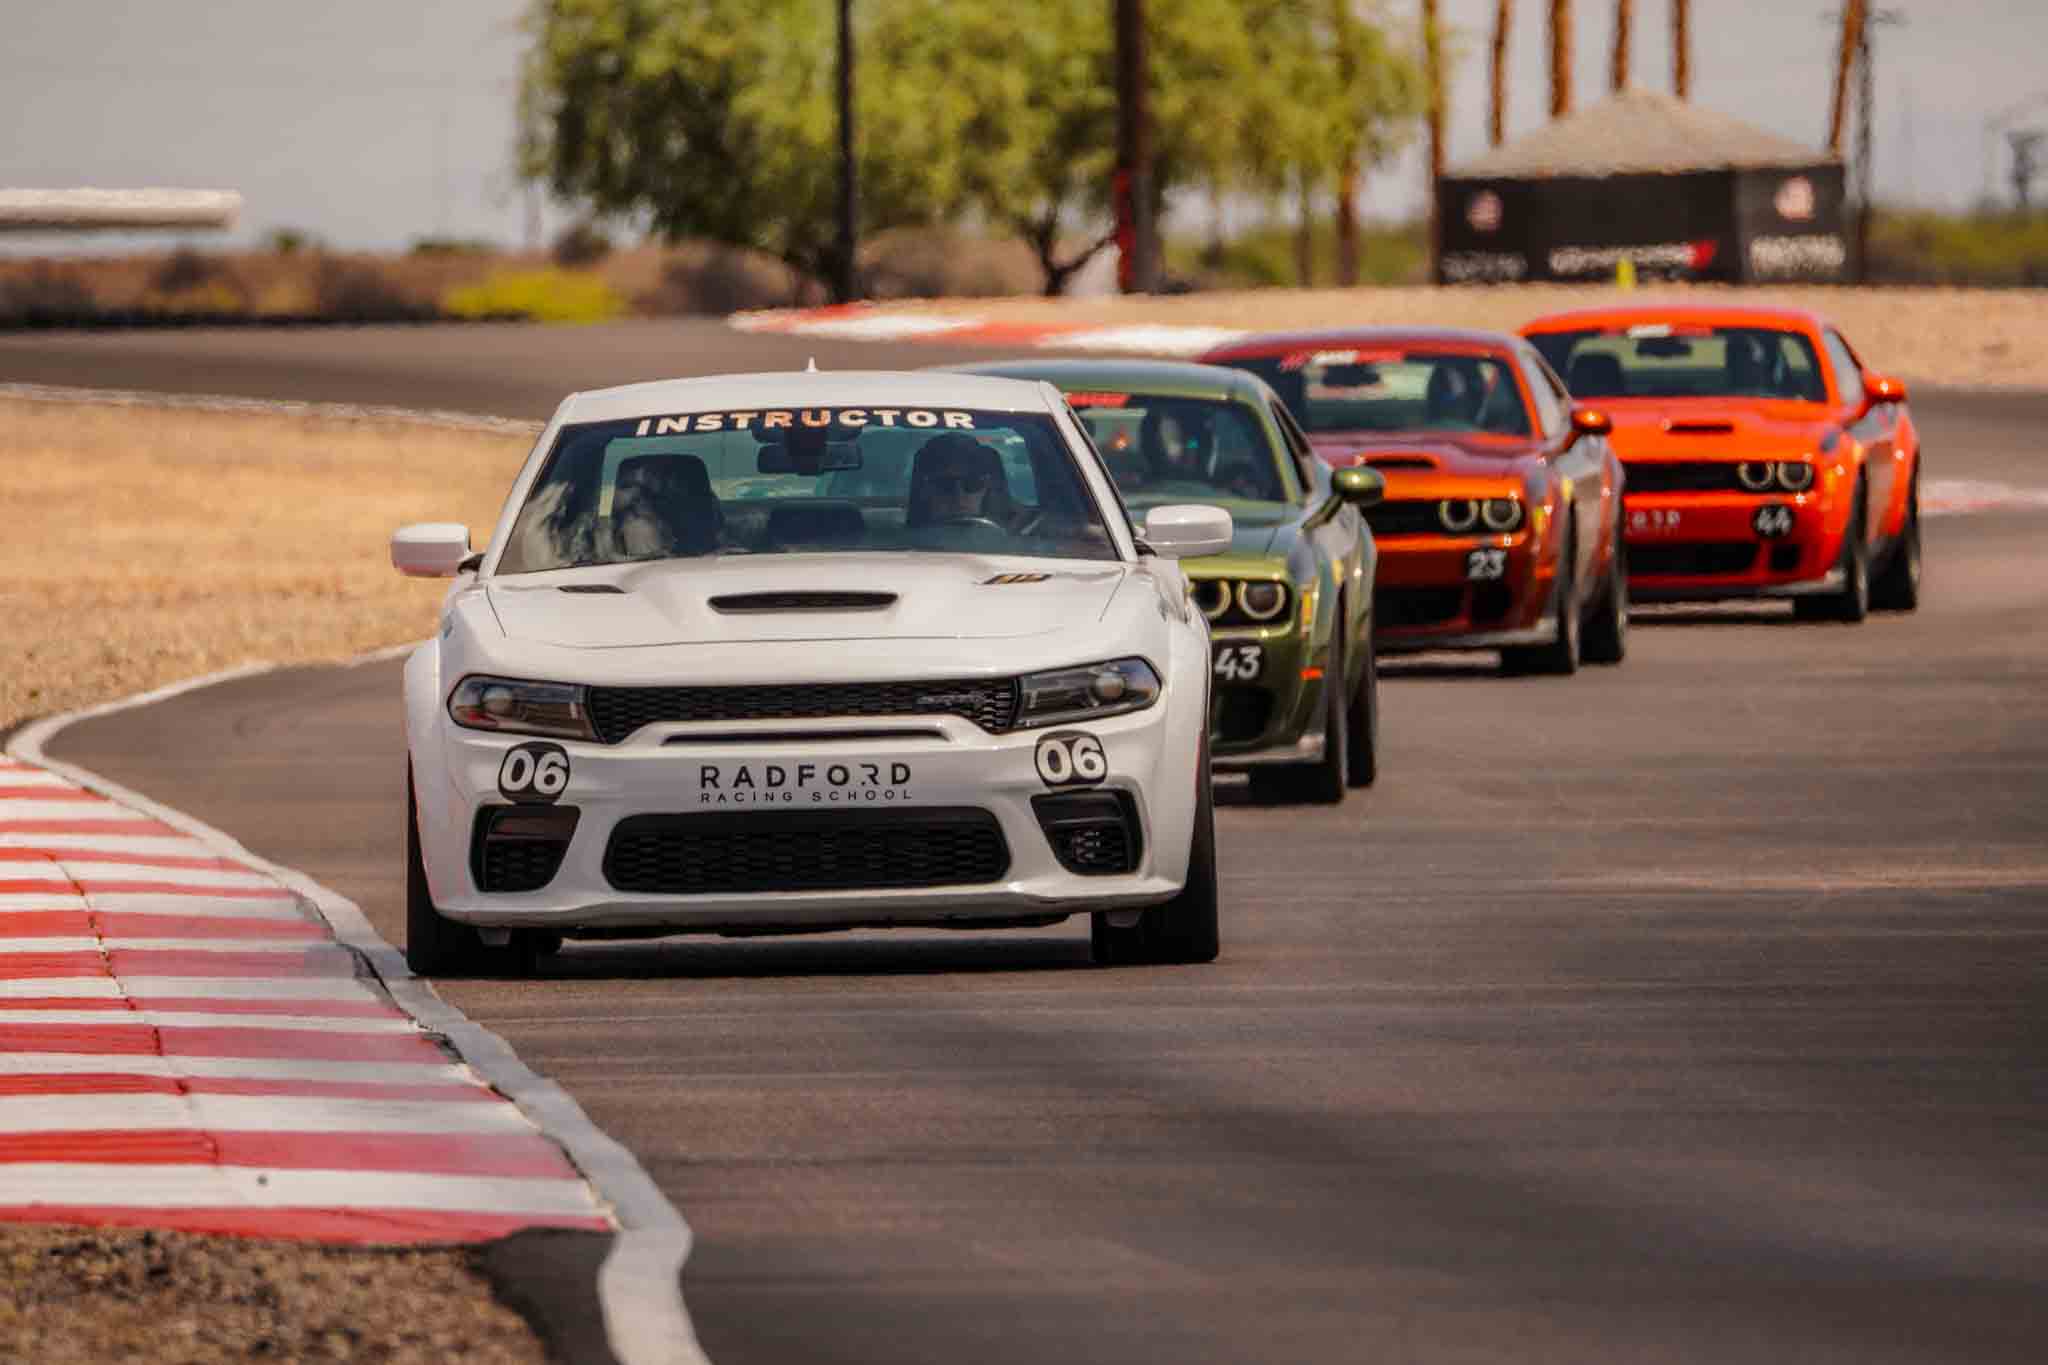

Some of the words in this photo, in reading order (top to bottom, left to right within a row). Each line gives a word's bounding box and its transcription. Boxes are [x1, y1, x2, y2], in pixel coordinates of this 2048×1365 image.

[635, 409, 975, 436] INSTRUCTOR
[1468, 551, 1506, 579] 23
[1213, 645, 1262, 680] 43
[503, 748, 568, 795] 06
[1037, 736, 1105, 781] 06
[700, 762, 913, 790] RADFORD
[700, 791, 793, 803] RACING
[813, 790, 913, 802] SCHOOL
